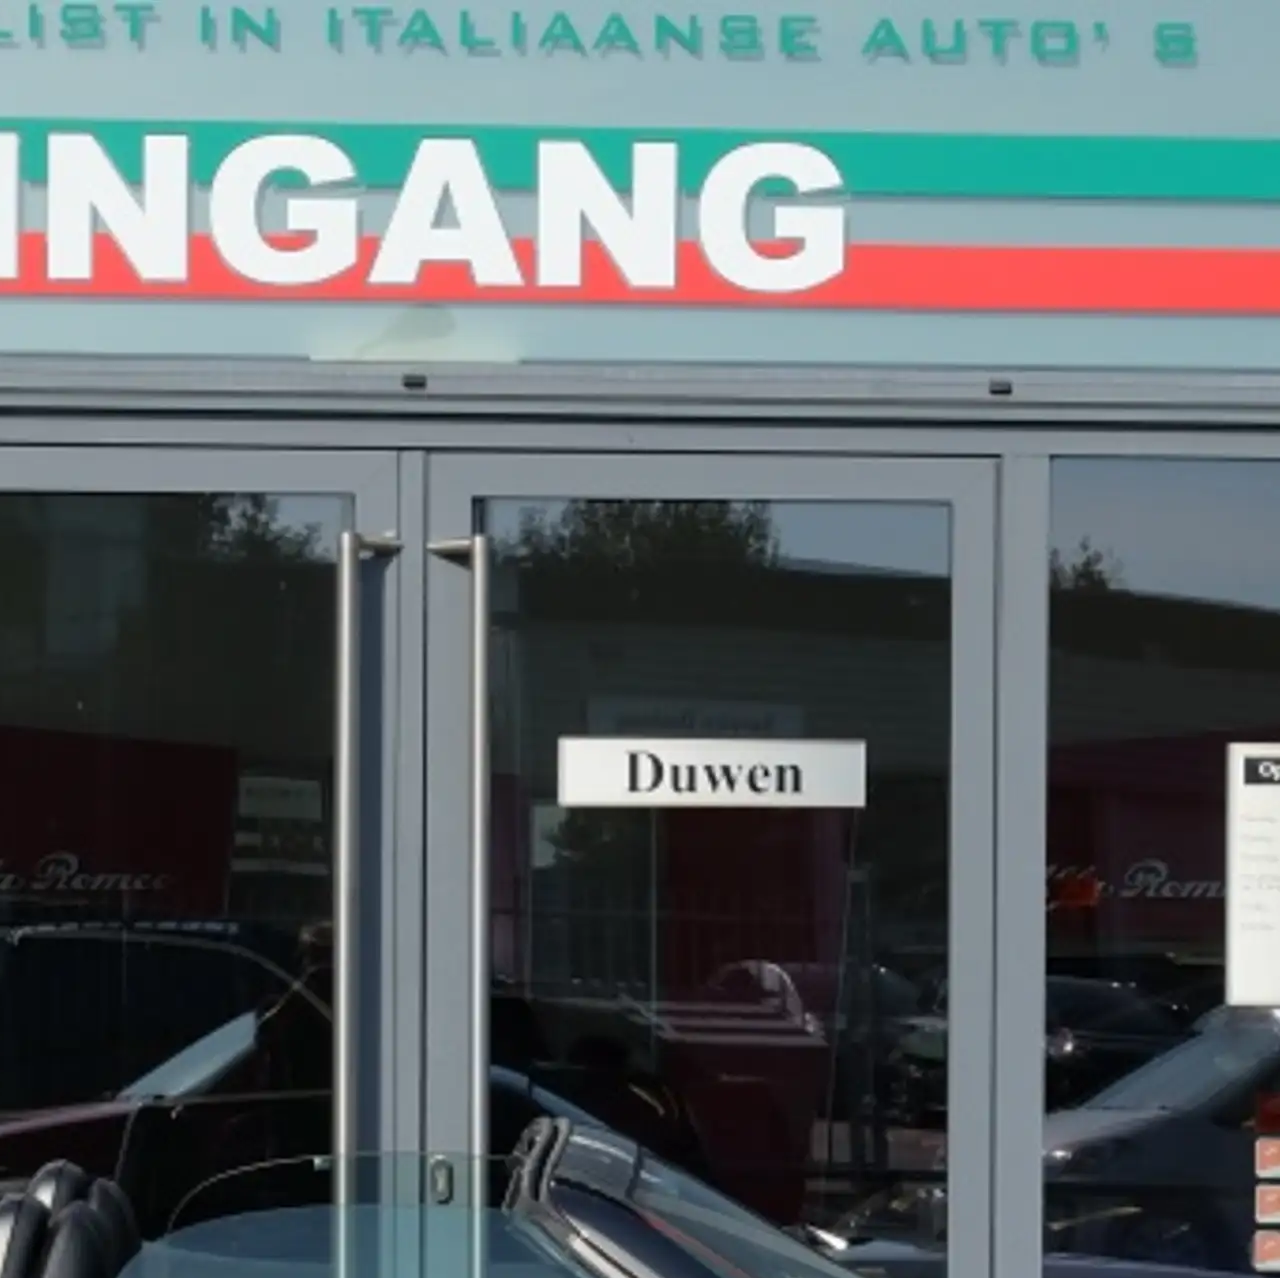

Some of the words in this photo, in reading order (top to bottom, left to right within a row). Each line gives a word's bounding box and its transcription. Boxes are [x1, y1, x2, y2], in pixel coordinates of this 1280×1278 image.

[198, 4, 282, 48] IN
[324, 5, 820, 58] ITALIAANSE
[626, 750, 803, 794] Duwen
